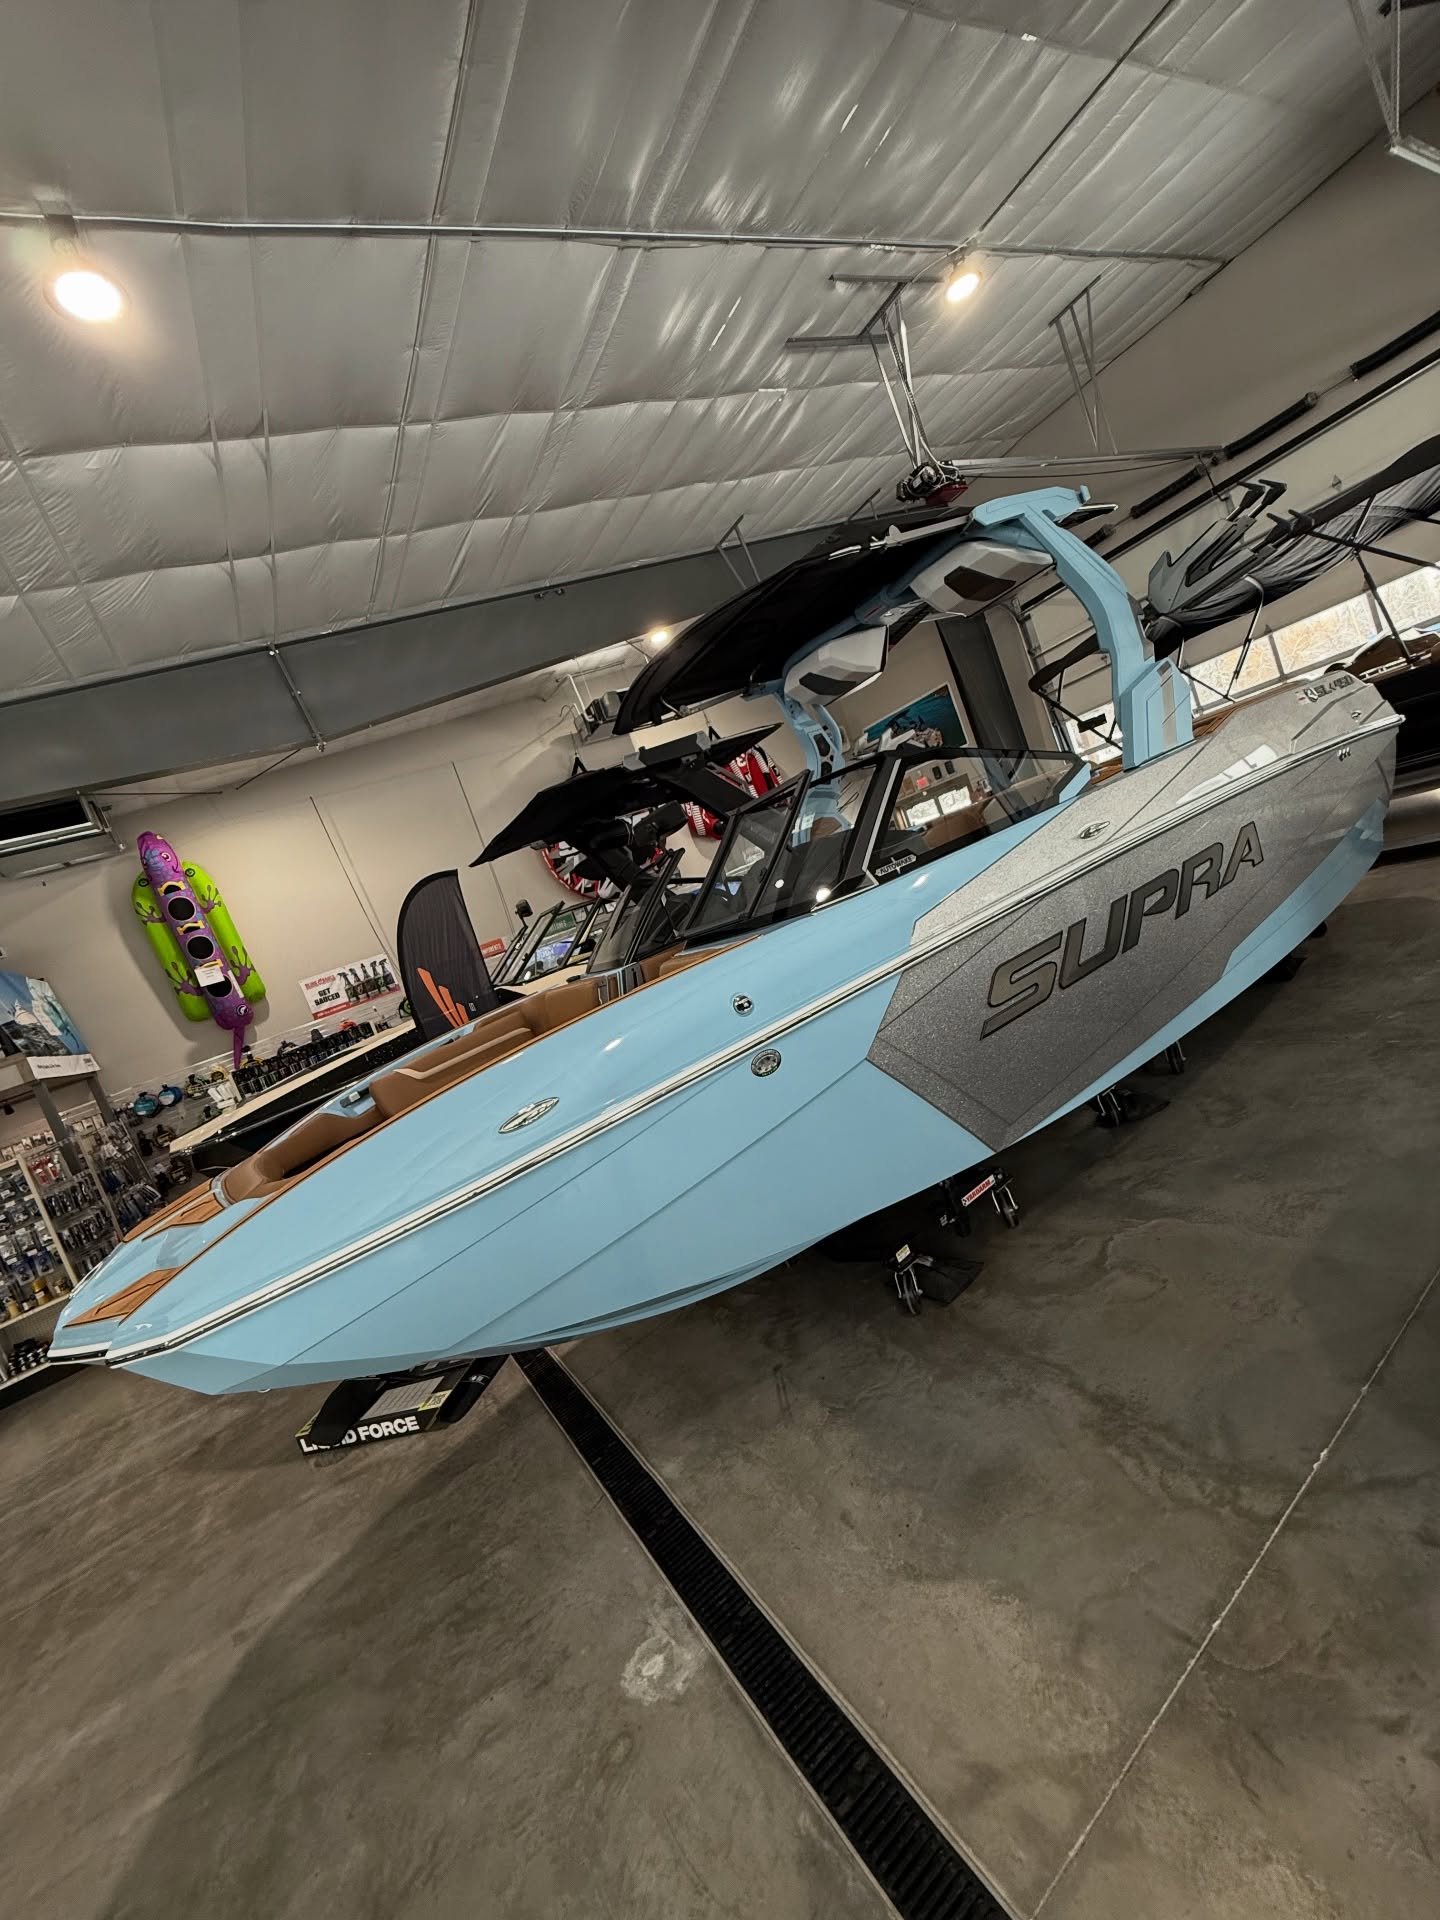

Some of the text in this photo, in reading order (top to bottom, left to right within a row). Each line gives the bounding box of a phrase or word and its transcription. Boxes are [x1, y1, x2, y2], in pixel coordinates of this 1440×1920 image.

[880, 856, 912, 874] AUTOWAKE
[979, 820, 1264, 1041] SUPRA
[314, 992, 340, 1006] SAUCED
[318, 987, 331, 997] GET
[965, 1179, 991, 1202] YARDARM
[357, 1416, 420, 1440] FORCE
